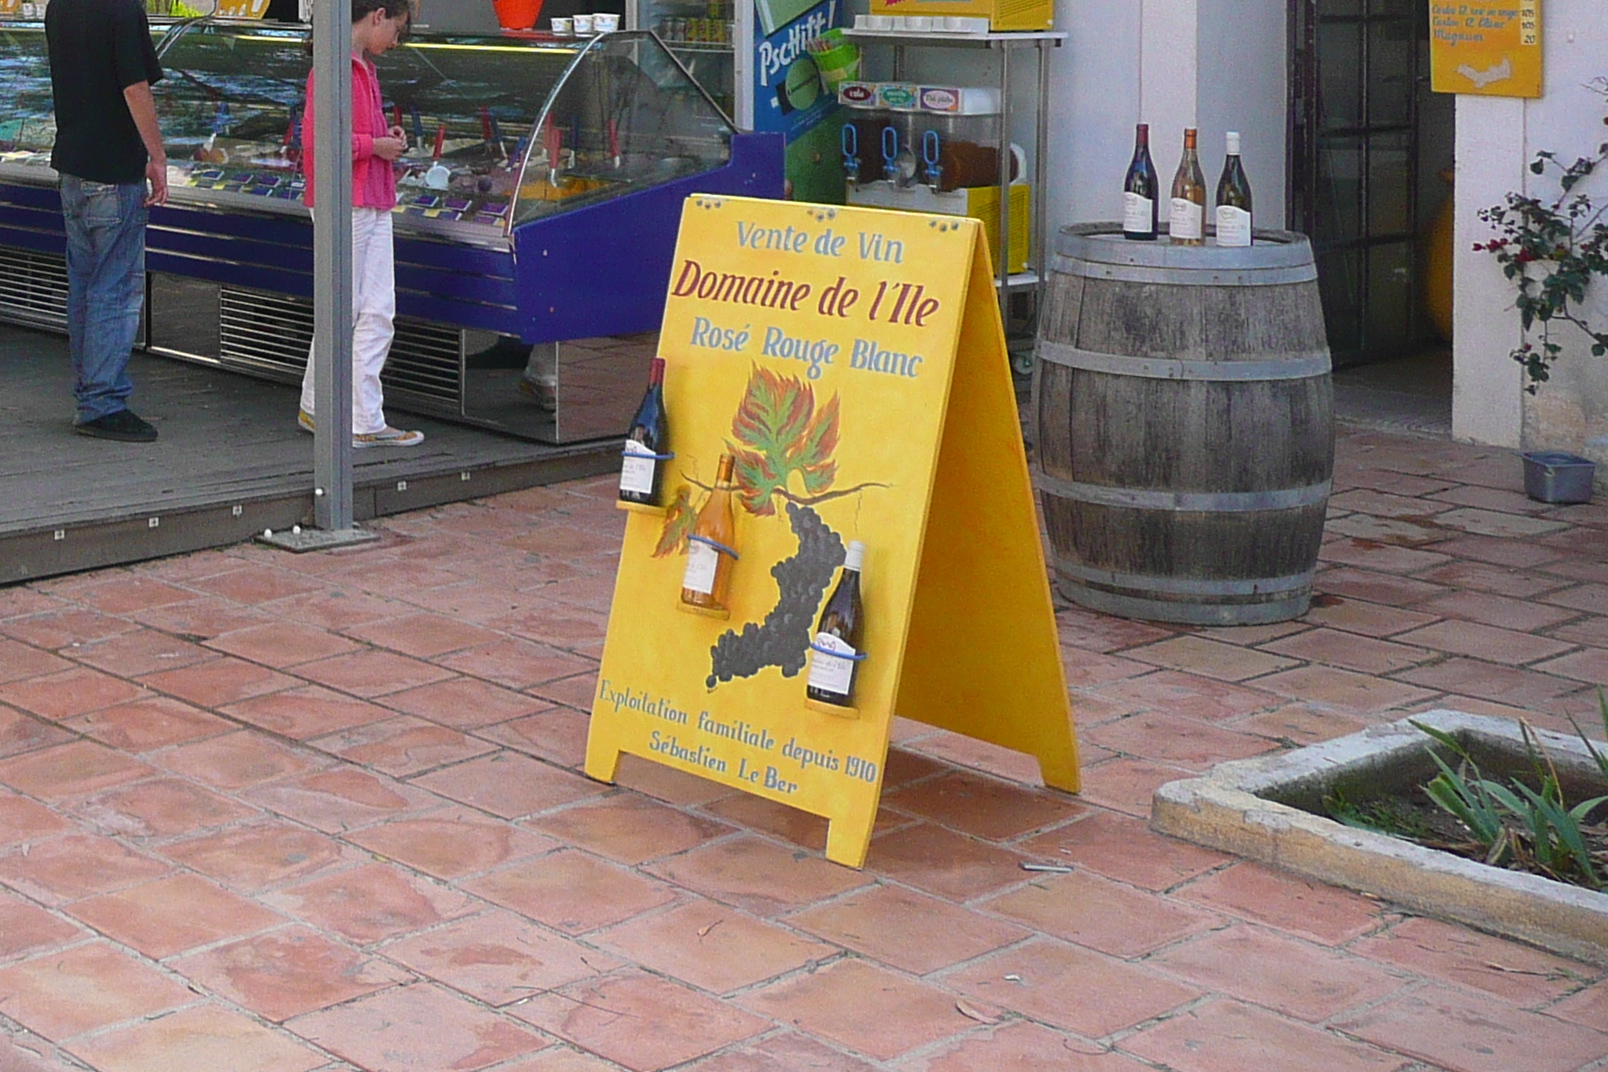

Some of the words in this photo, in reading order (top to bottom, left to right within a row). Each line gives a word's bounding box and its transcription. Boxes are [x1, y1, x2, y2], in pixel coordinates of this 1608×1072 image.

[736, 220, 808, 254] Vente
[813, 228, 846, 258] de
[857, 231, 904, 264] Vin
[670, 260, 811, 313] Domaine
[818, 276, 860, 319] de
[691, 316, 750, 352] Rosé
[761, 325, 839, 380] Rouge
[850, 338, 924, 378] Blanc
[598, 679, 688, 726] Exploitation
[697, 711, 776, 751] familiale
[781, 736, 840, 772] depuis
[845, 756, 877, 783] 1910
[649, 731, 728, 773] Sébastien
[738, 758, 760, 783] Le
[764, 766, 799, 795] Ber
